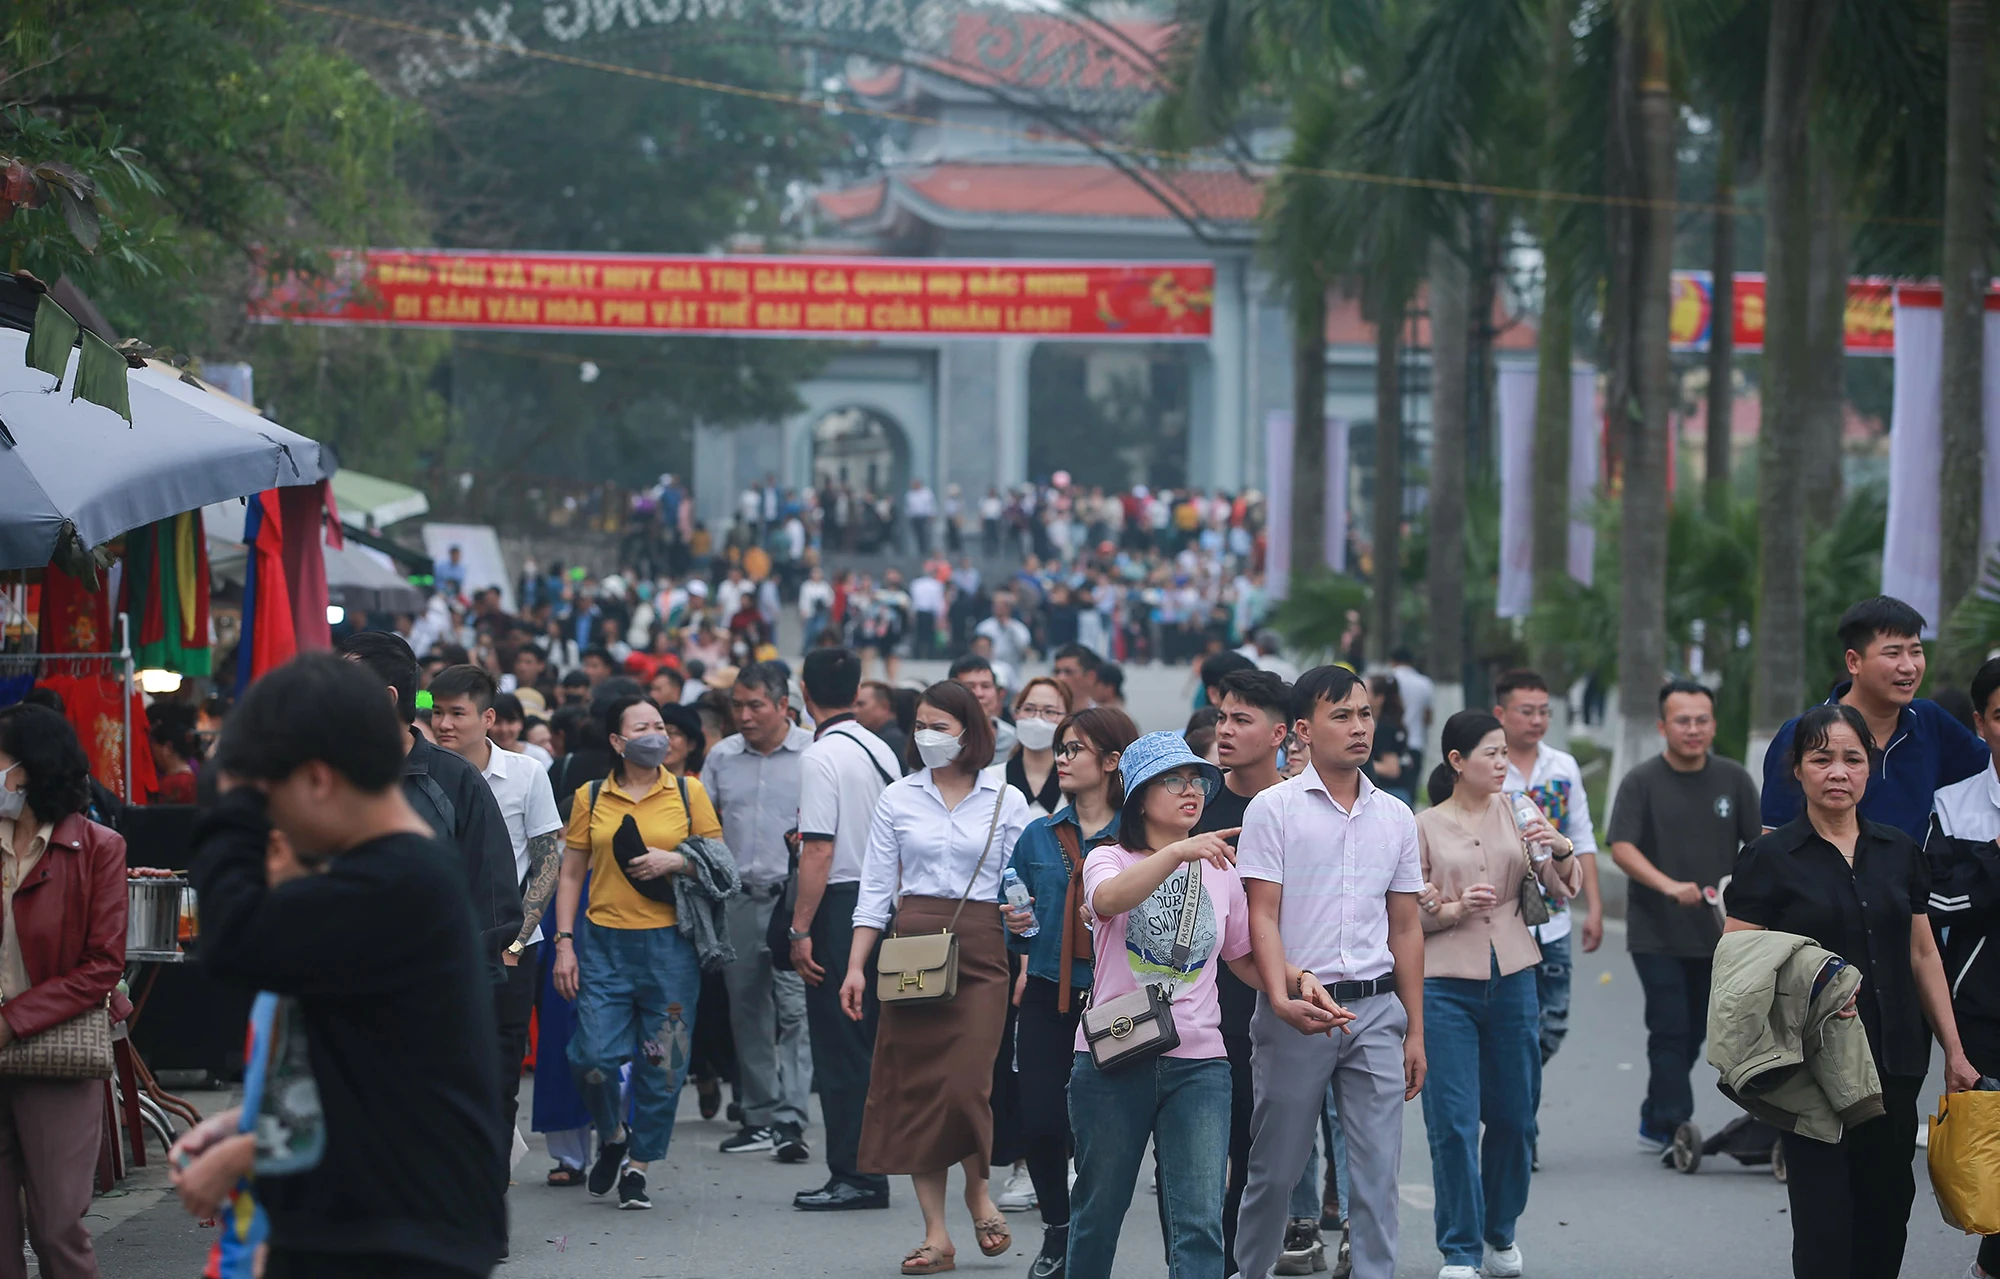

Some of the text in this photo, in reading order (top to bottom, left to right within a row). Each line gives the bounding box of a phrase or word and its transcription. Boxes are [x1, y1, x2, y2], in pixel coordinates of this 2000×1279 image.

[492, 260, 526, 289] VÀ
[531, 261, 598, 291] PHÁT
[602, 265, 655, 291] HUY
[658, 262, 703, 292] GIÁ
[812, 269, 849, 296] CA
[394, 293, 421, 319] DI
[427, 289, 482, 320] SẢN
[486, 292, 540, 321] VĂN
[602, 298, 647, 324] PHI
[650, 296, 699, 328] VẬT
[1180, 908, 1194, 944] FASHION
